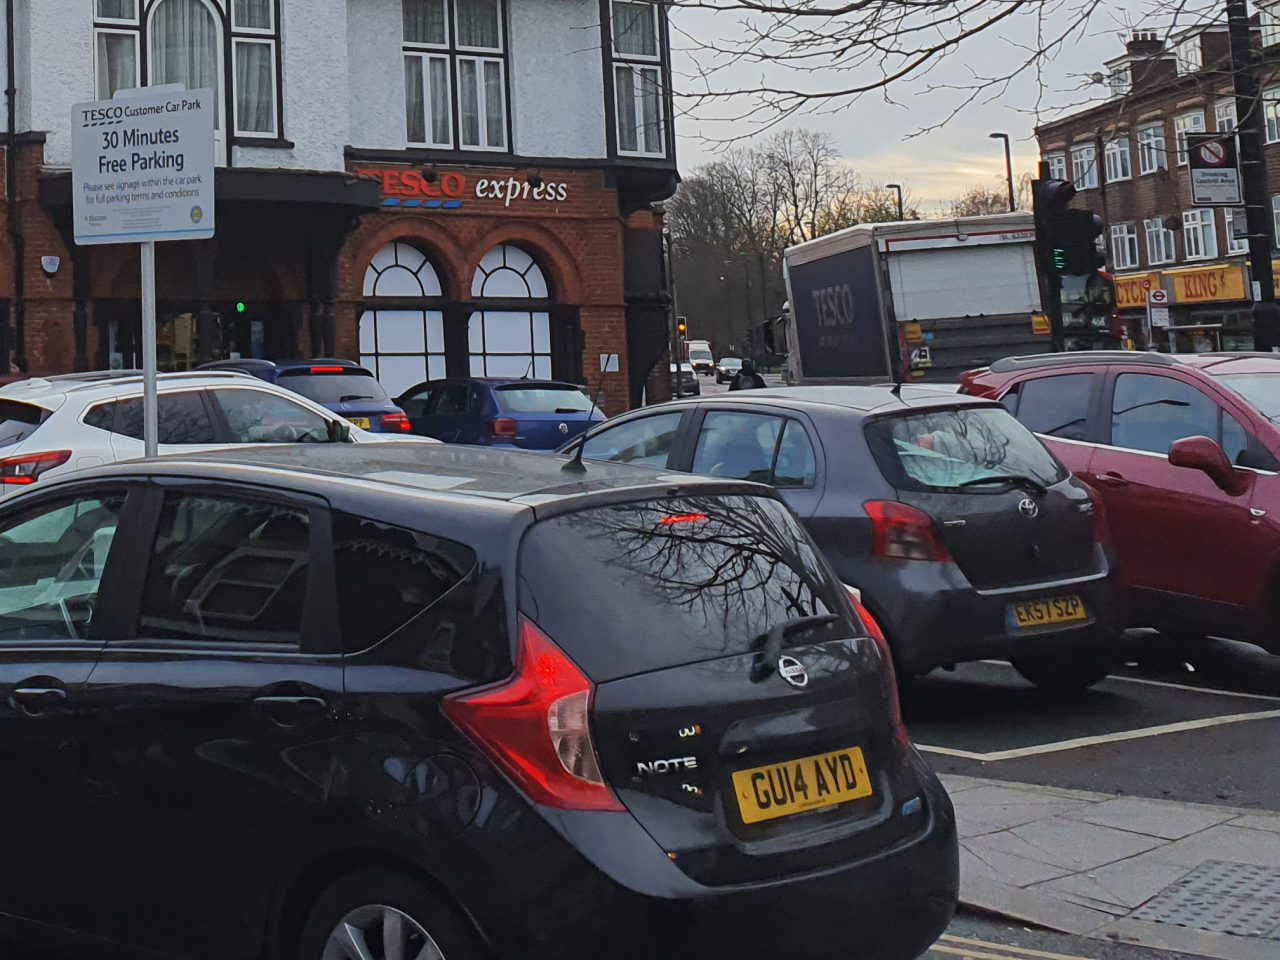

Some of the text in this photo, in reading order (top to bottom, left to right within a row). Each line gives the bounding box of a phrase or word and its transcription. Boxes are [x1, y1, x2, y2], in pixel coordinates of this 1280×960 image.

[81, 98, 201, 122] TESCO Customer Car Park
[102, 127, 180, 150] 30 Minutes
[99, 150, 185, 174] Free Parking
[83, 182, 102, 192] Please
[104, 183, 115, 191] see
[141, 177, 161, 188] within
[163, 177, 174, 186] the
[175, 177, 185, 185] car
[187, 174, 202, 186] park
[151, 189, 164, 199] and
[475, 176, 568, 207] express
[1116, 271, 1218, 304] CYCL KING
[812, 283, 853, 327] TESCO
[1016, 597, 1080, 622] EK57 SZP
[636, 756, 698, 776] NOTE
[750, 753, 858, 810] GU14 AYD
